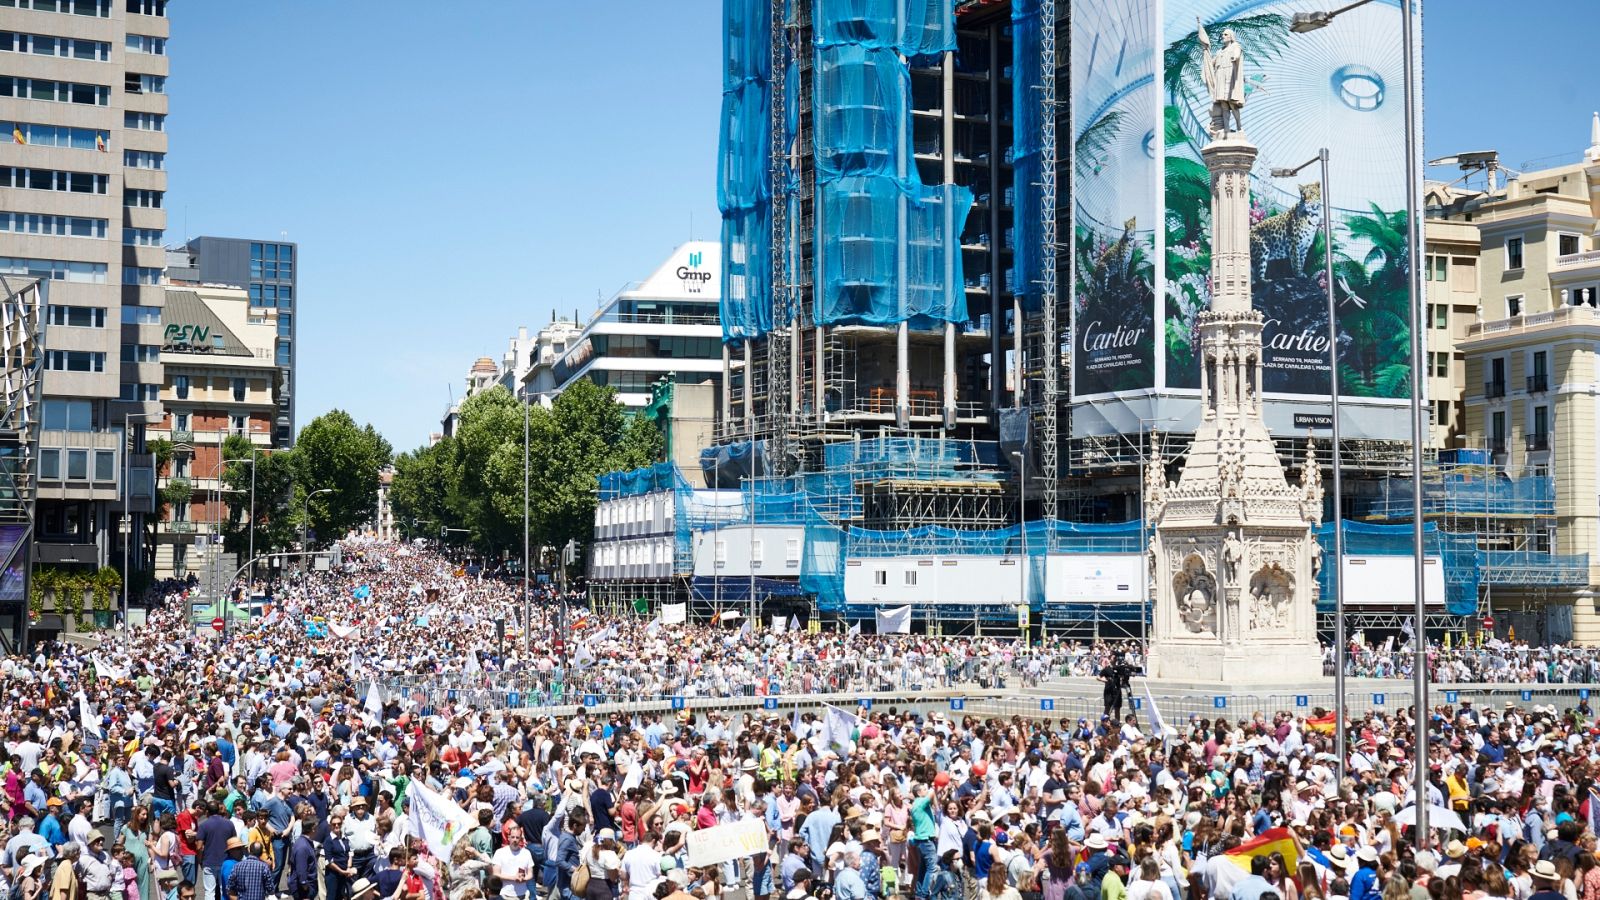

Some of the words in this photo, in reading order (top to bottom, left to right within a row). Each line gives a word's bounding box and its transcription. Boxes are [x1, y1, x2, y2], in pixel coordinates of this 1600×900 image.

[676, 266, 712, 284] Gmp
[164, 324, 210, 342] PSN
[1083, 320, 1144, 352] Cartier
[1261, 318, 1339, 353] Cartier
